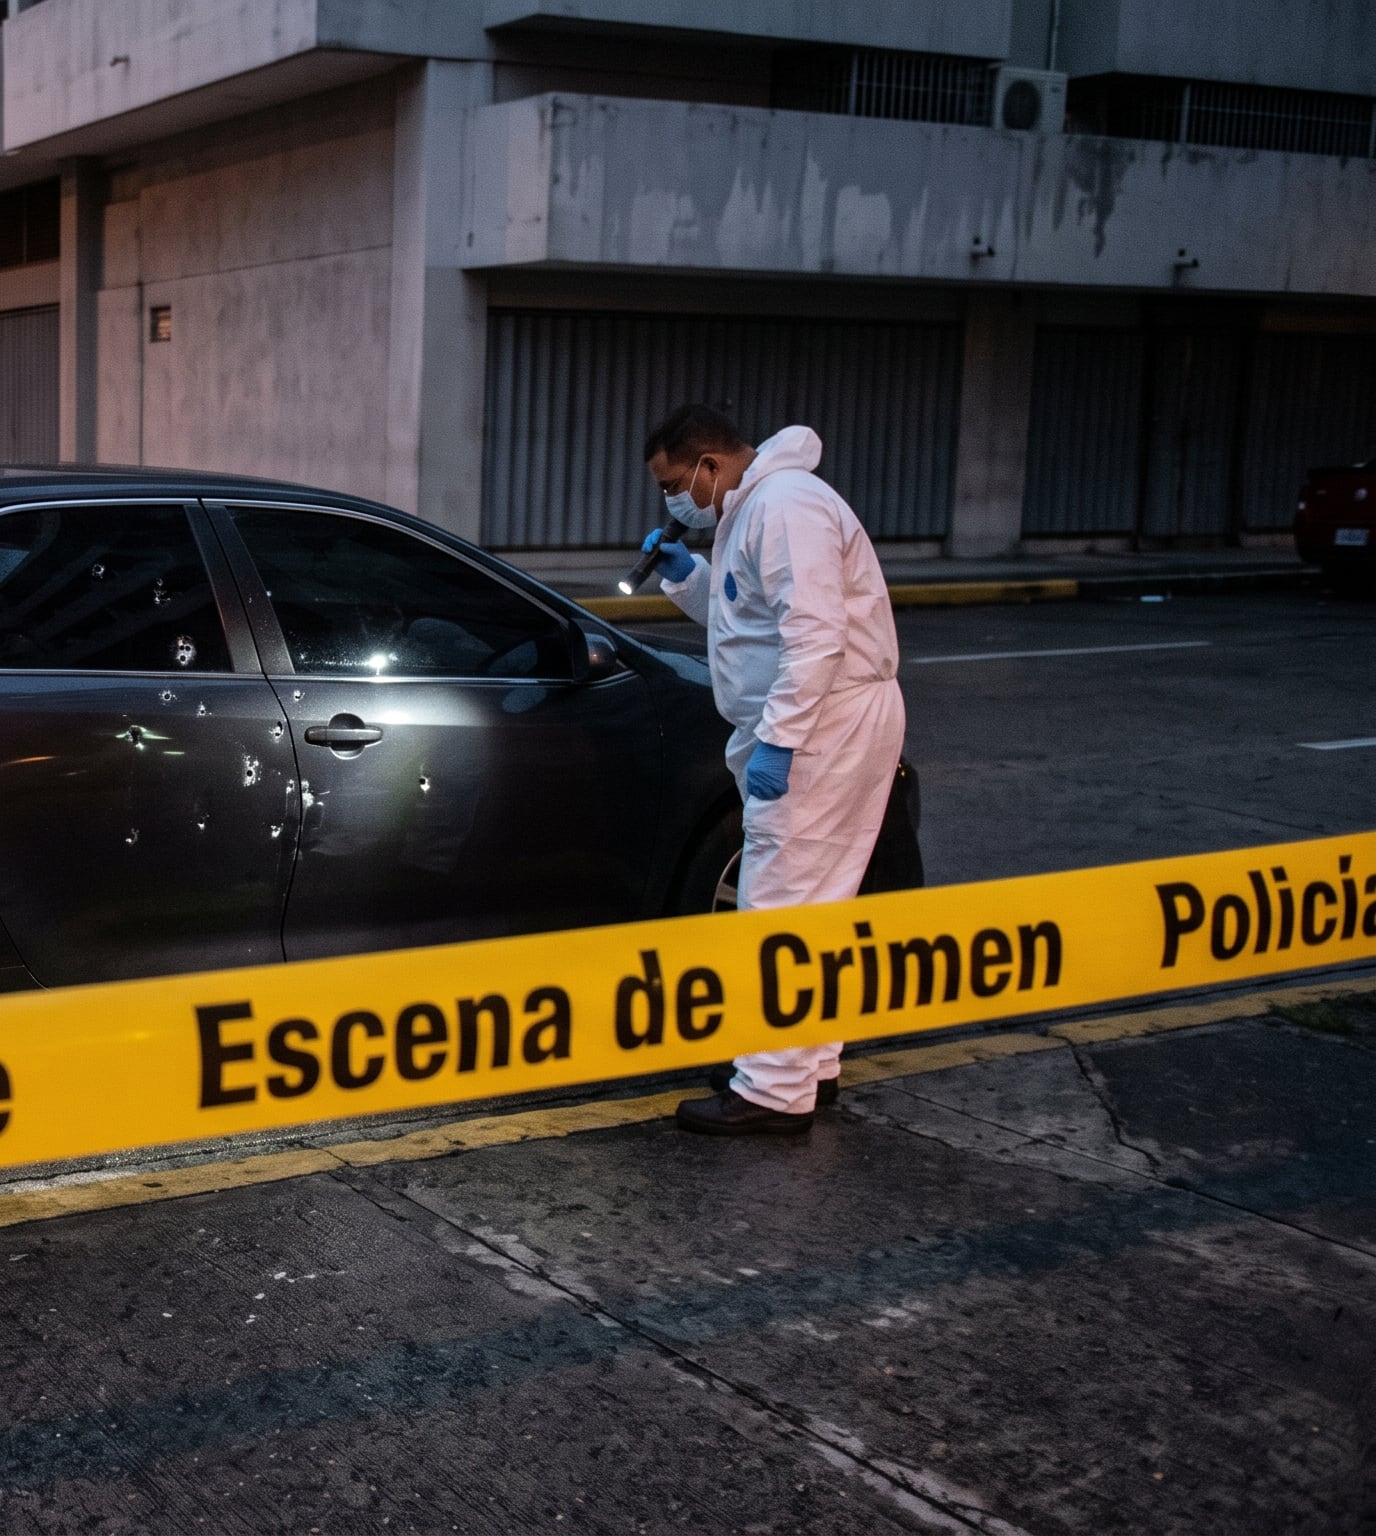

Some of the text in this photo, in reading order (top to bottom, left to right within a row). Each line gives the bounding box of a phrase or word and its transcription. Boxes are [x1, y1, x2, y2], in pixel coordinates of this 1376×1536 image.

[195, 987, 572, 1109] Escena
[614, 950, 724, 1051] de
[759, 921, 1063, 1029] Crimen
